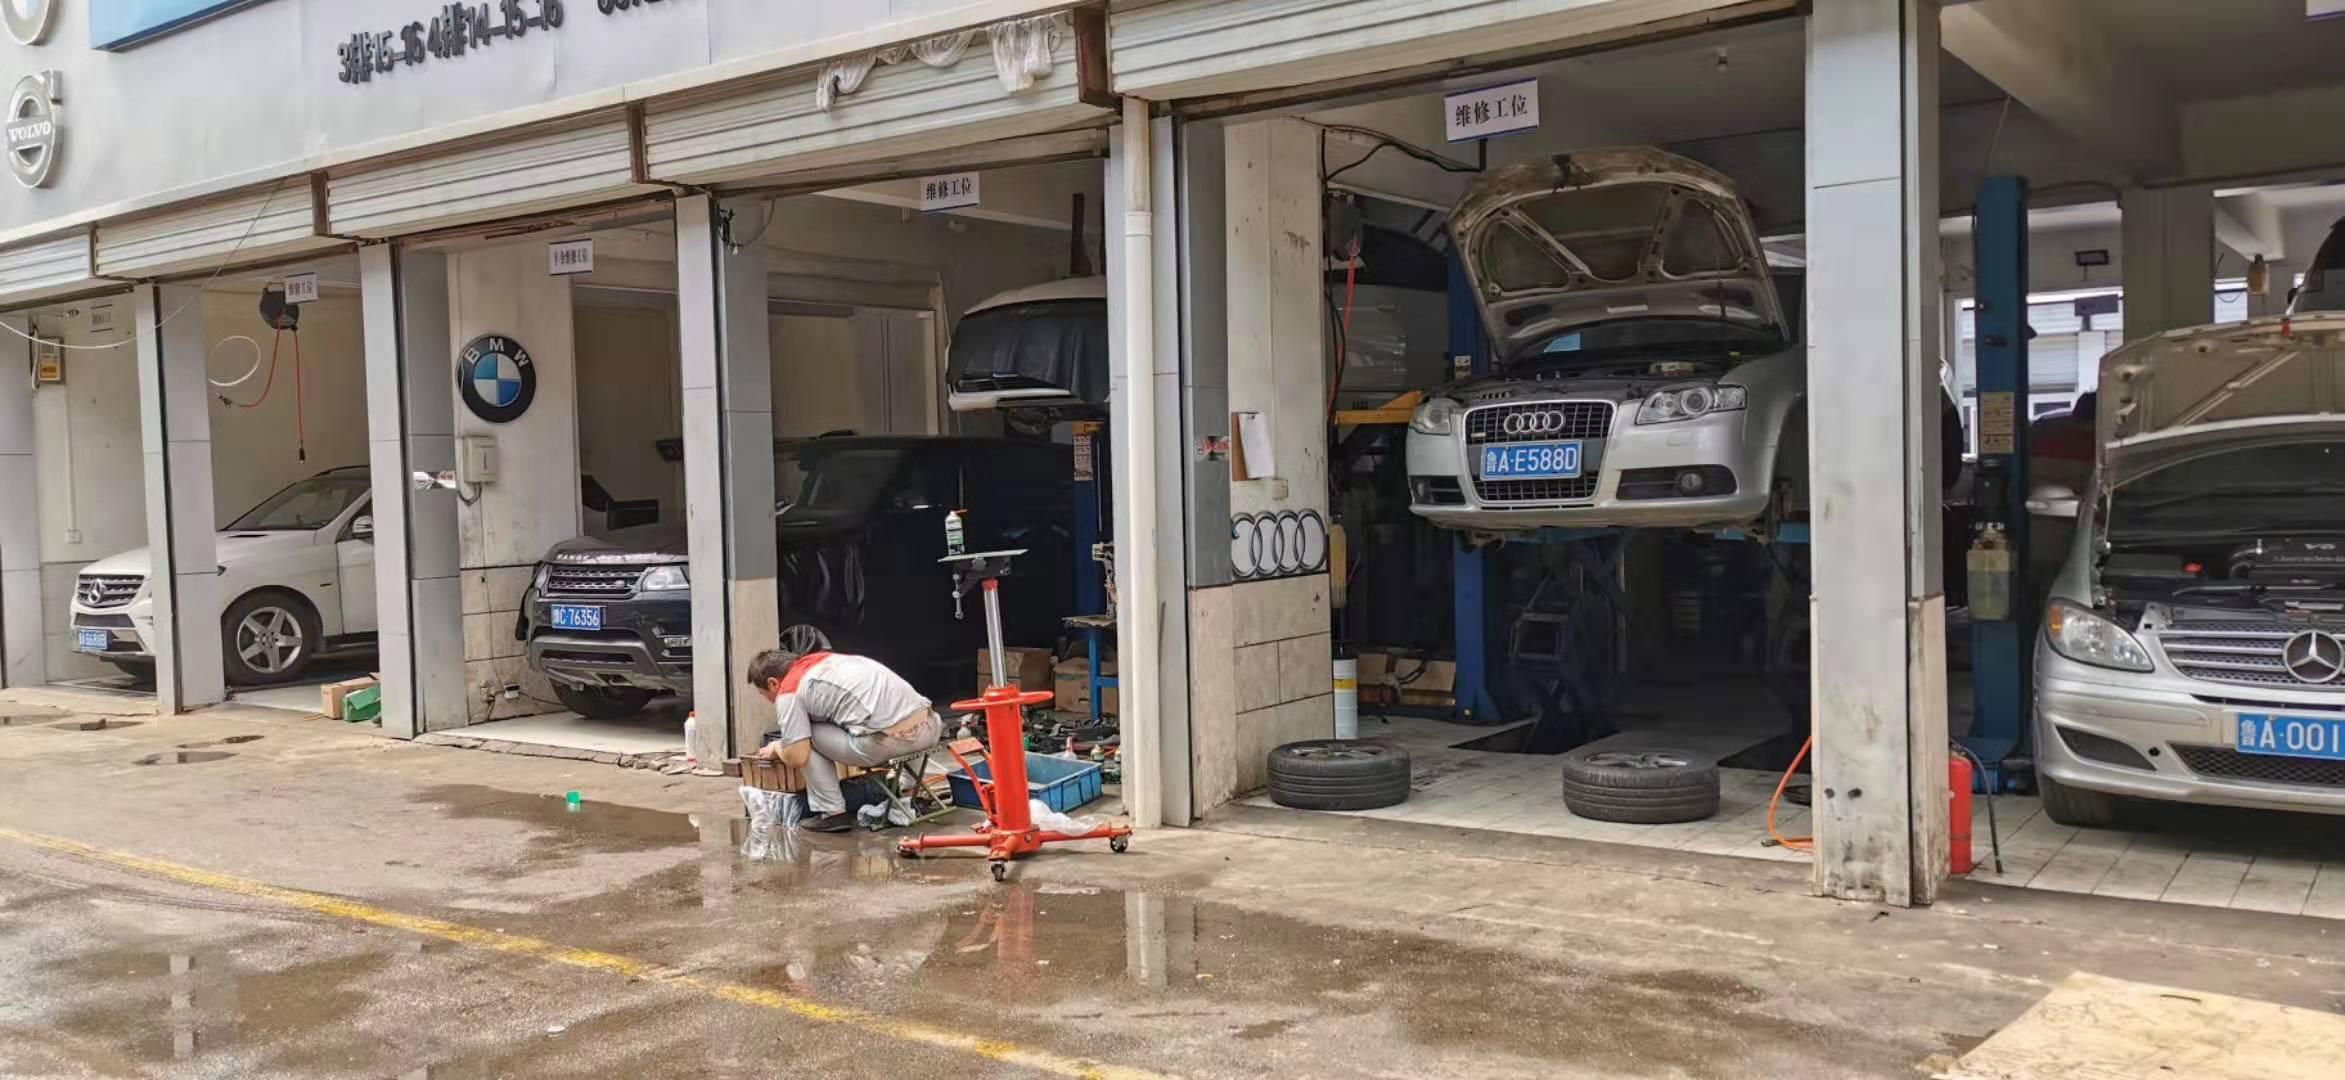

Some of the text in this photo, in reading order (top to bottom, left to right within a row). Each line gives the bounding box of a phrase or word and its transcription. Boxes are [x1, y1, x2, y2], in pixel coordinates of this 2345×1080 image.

[1455, 94, 1528, 127] 维修工位
[8, 121, 52, 142] VOLVO
[926, 177, 973, 200] 维修工位
[464, 337, 529, 367] BMW
